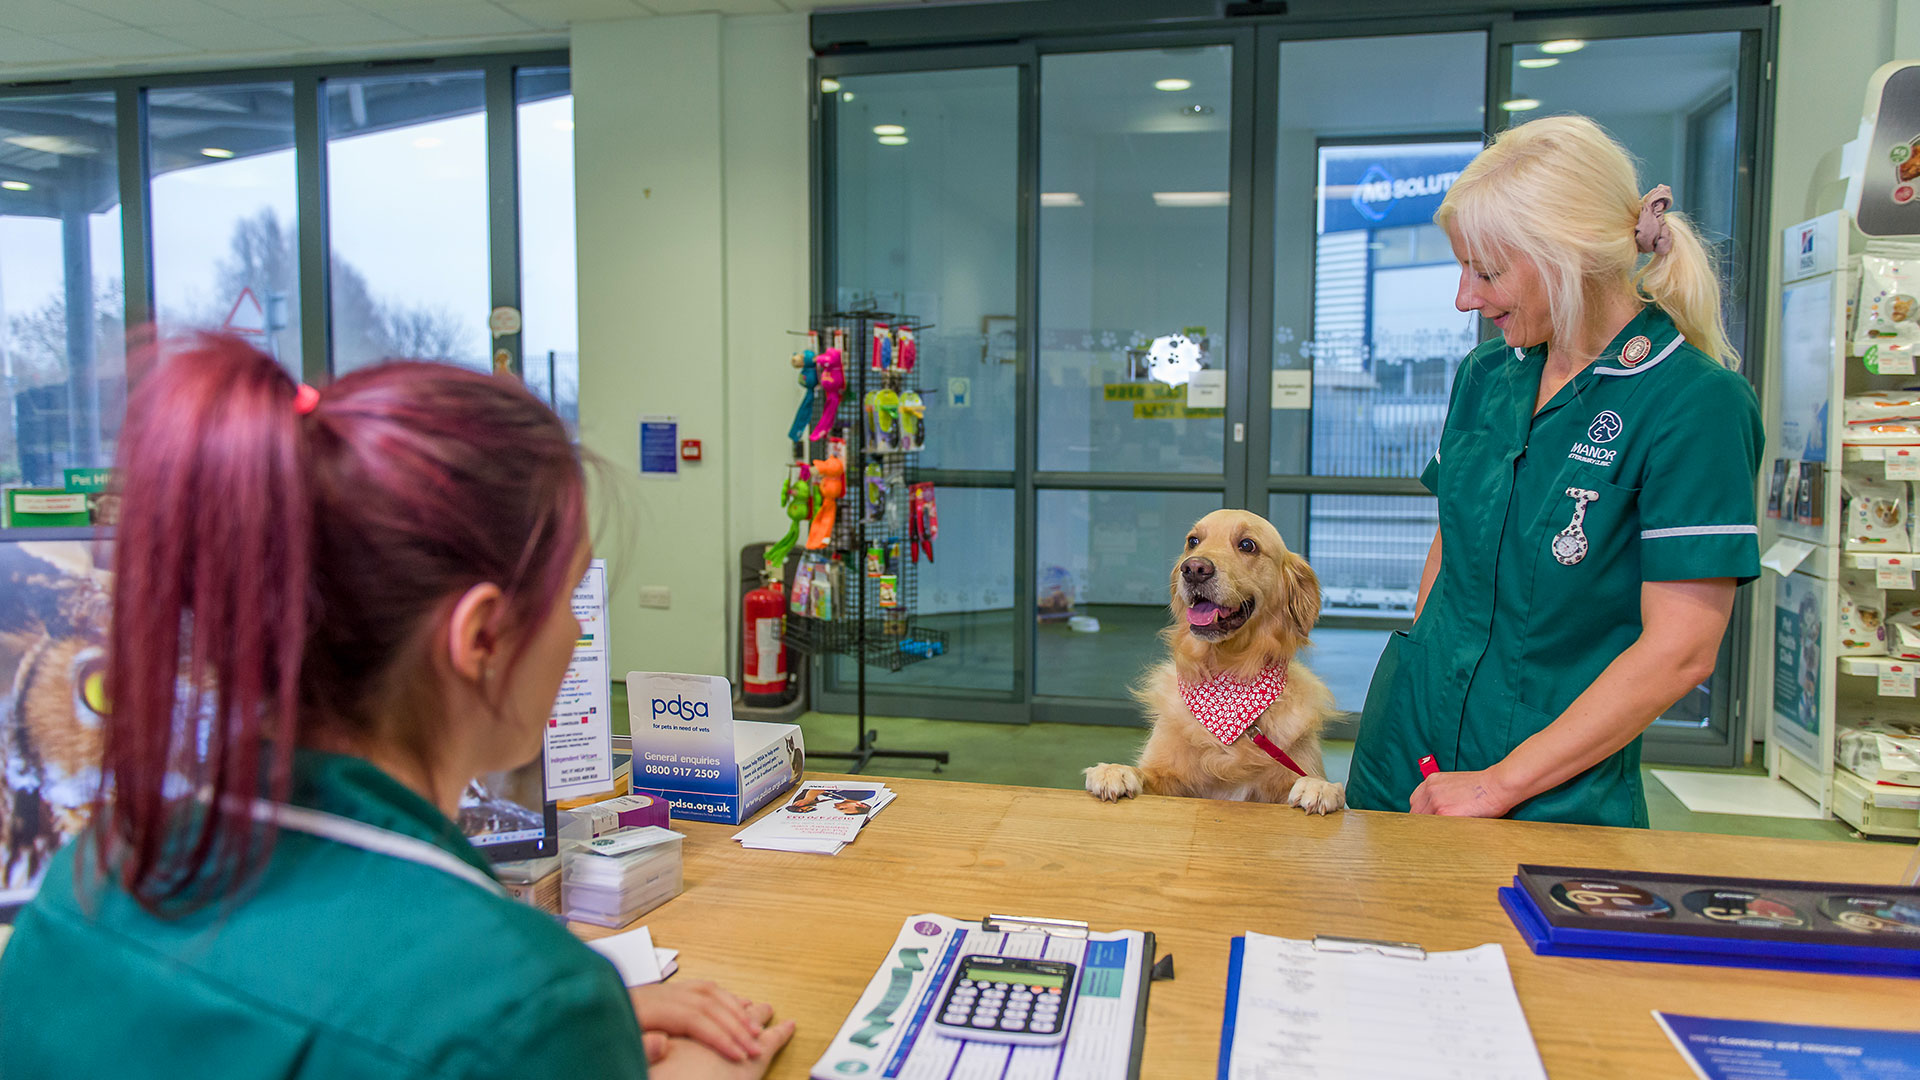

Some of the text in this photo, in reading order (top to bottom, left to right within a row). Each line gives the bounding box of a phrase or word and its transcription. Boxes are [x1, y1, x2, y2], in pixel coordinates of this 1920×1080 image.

[1571, 442, 1617, 461] MANOR
[651, 693, 709, 721] pdsa
[644, 752, 720, 766] General enquiries
[645, 764, 720, 779] 0800 917 2509
